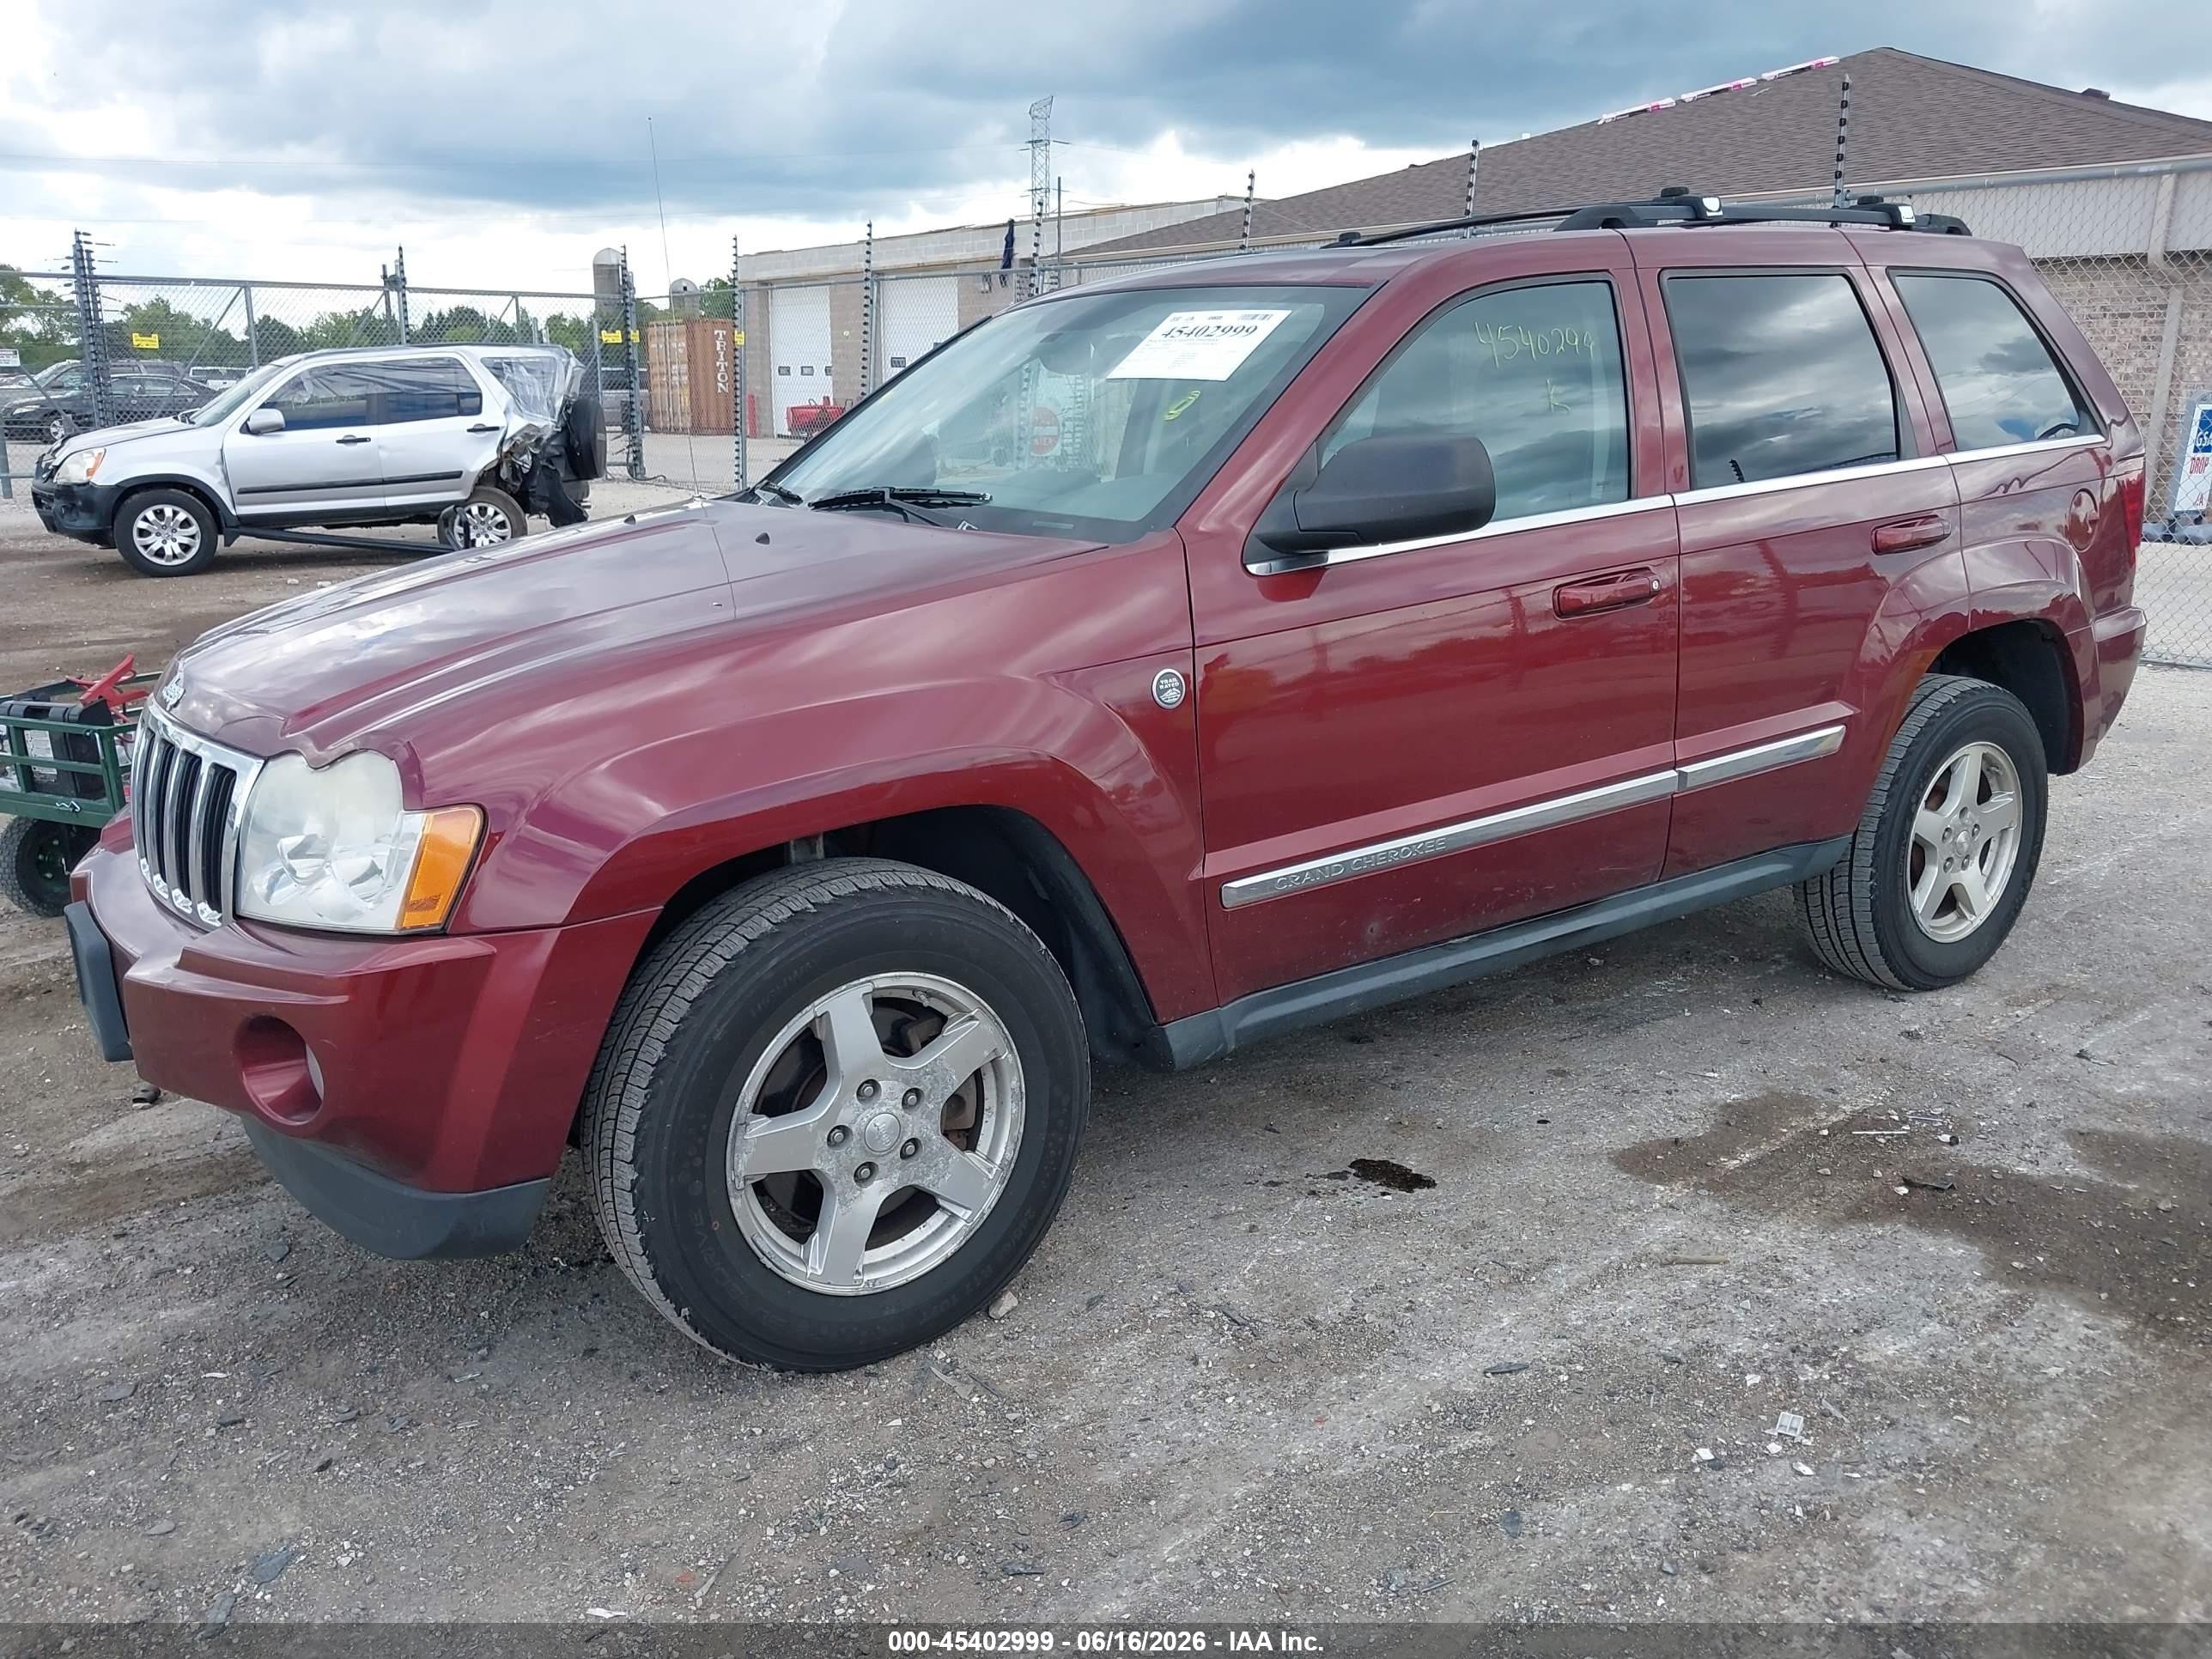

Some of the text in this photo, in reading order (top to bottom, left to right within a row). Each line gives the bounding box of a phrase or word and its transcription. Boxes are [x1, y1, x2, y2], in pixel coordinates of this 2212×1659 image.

[1161, 325, 1259, 337] 45402999
[714, 330, 730, 393] TRITON
[2189, 457, 2209, 474] DROP
[1274, 837, 1448, 890] GRAND CHEROKEE
